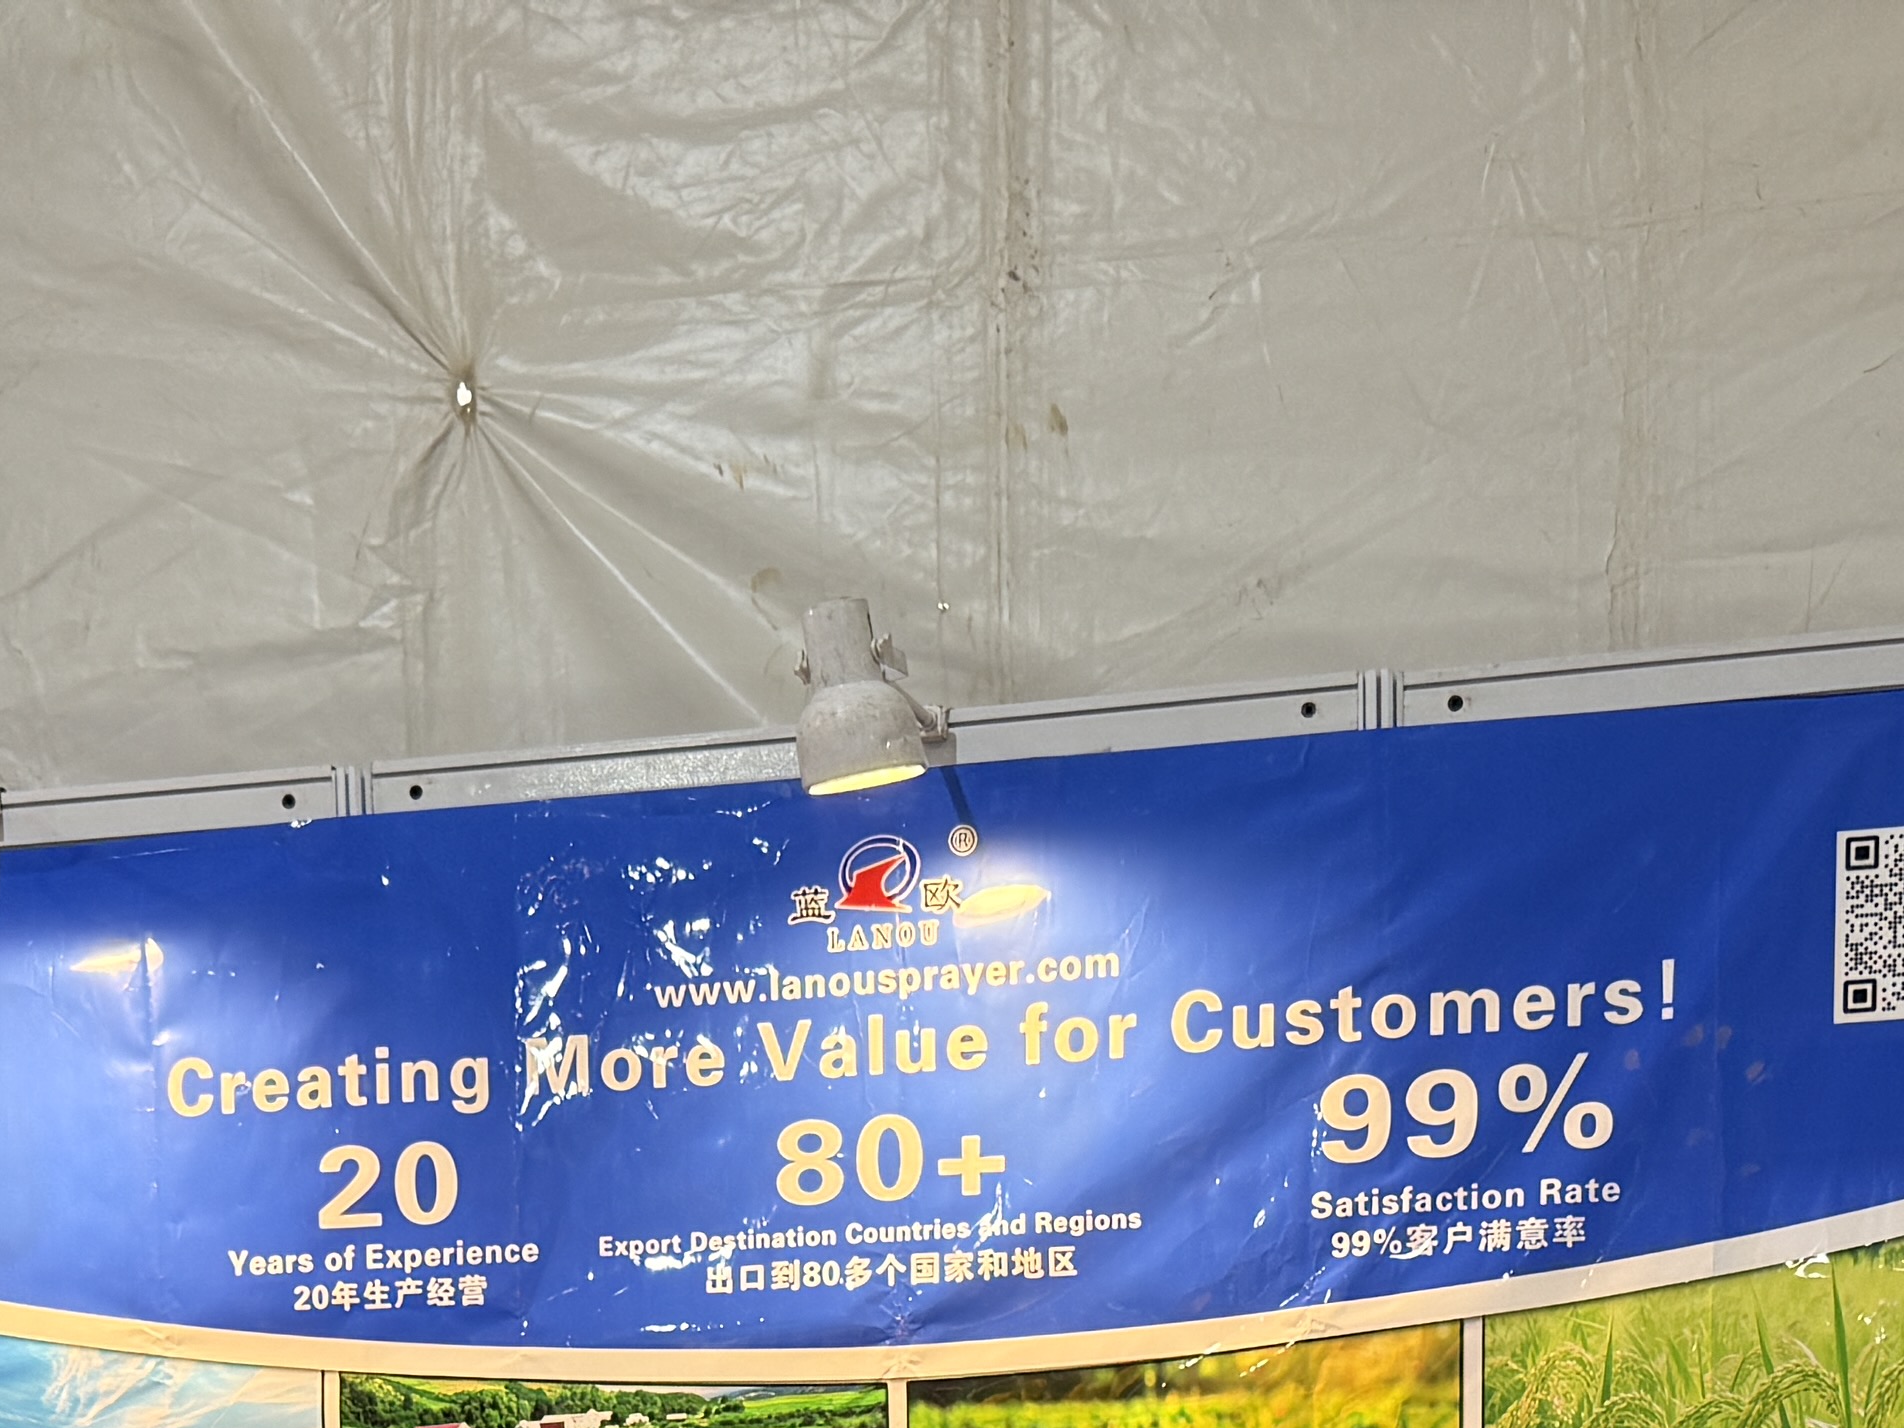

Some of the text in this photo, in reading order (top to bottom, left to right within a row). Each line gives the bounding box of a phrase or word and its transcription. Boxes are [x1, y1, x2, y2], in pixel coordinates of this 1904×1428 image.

[827, 919, 941, 952] LANOU
[654, 950, 1120, 1009] www.lanousprayer.com
[167, 958, 1676, 1117] Creating More Value for Customers!
[1319, 1052, 1614, 1164] 99%
[775, 1113, 1006, 1206] 80+
[317, 1140, 459, 1230] 20
[1311, 1177, 1622, 1219] Satisfaction Rate
[228, 1240, 539, 1277] Years of Experience
[599, 1208, 1142, 1260] Export Destination Countries and Regions
[1331, 1214, 1586, 1259] 99%客户满意率
[293, 1275, 488, 1312] 20年生产经营
[705, 1245, 1078, 1294] 出口到80多个国家和地区
